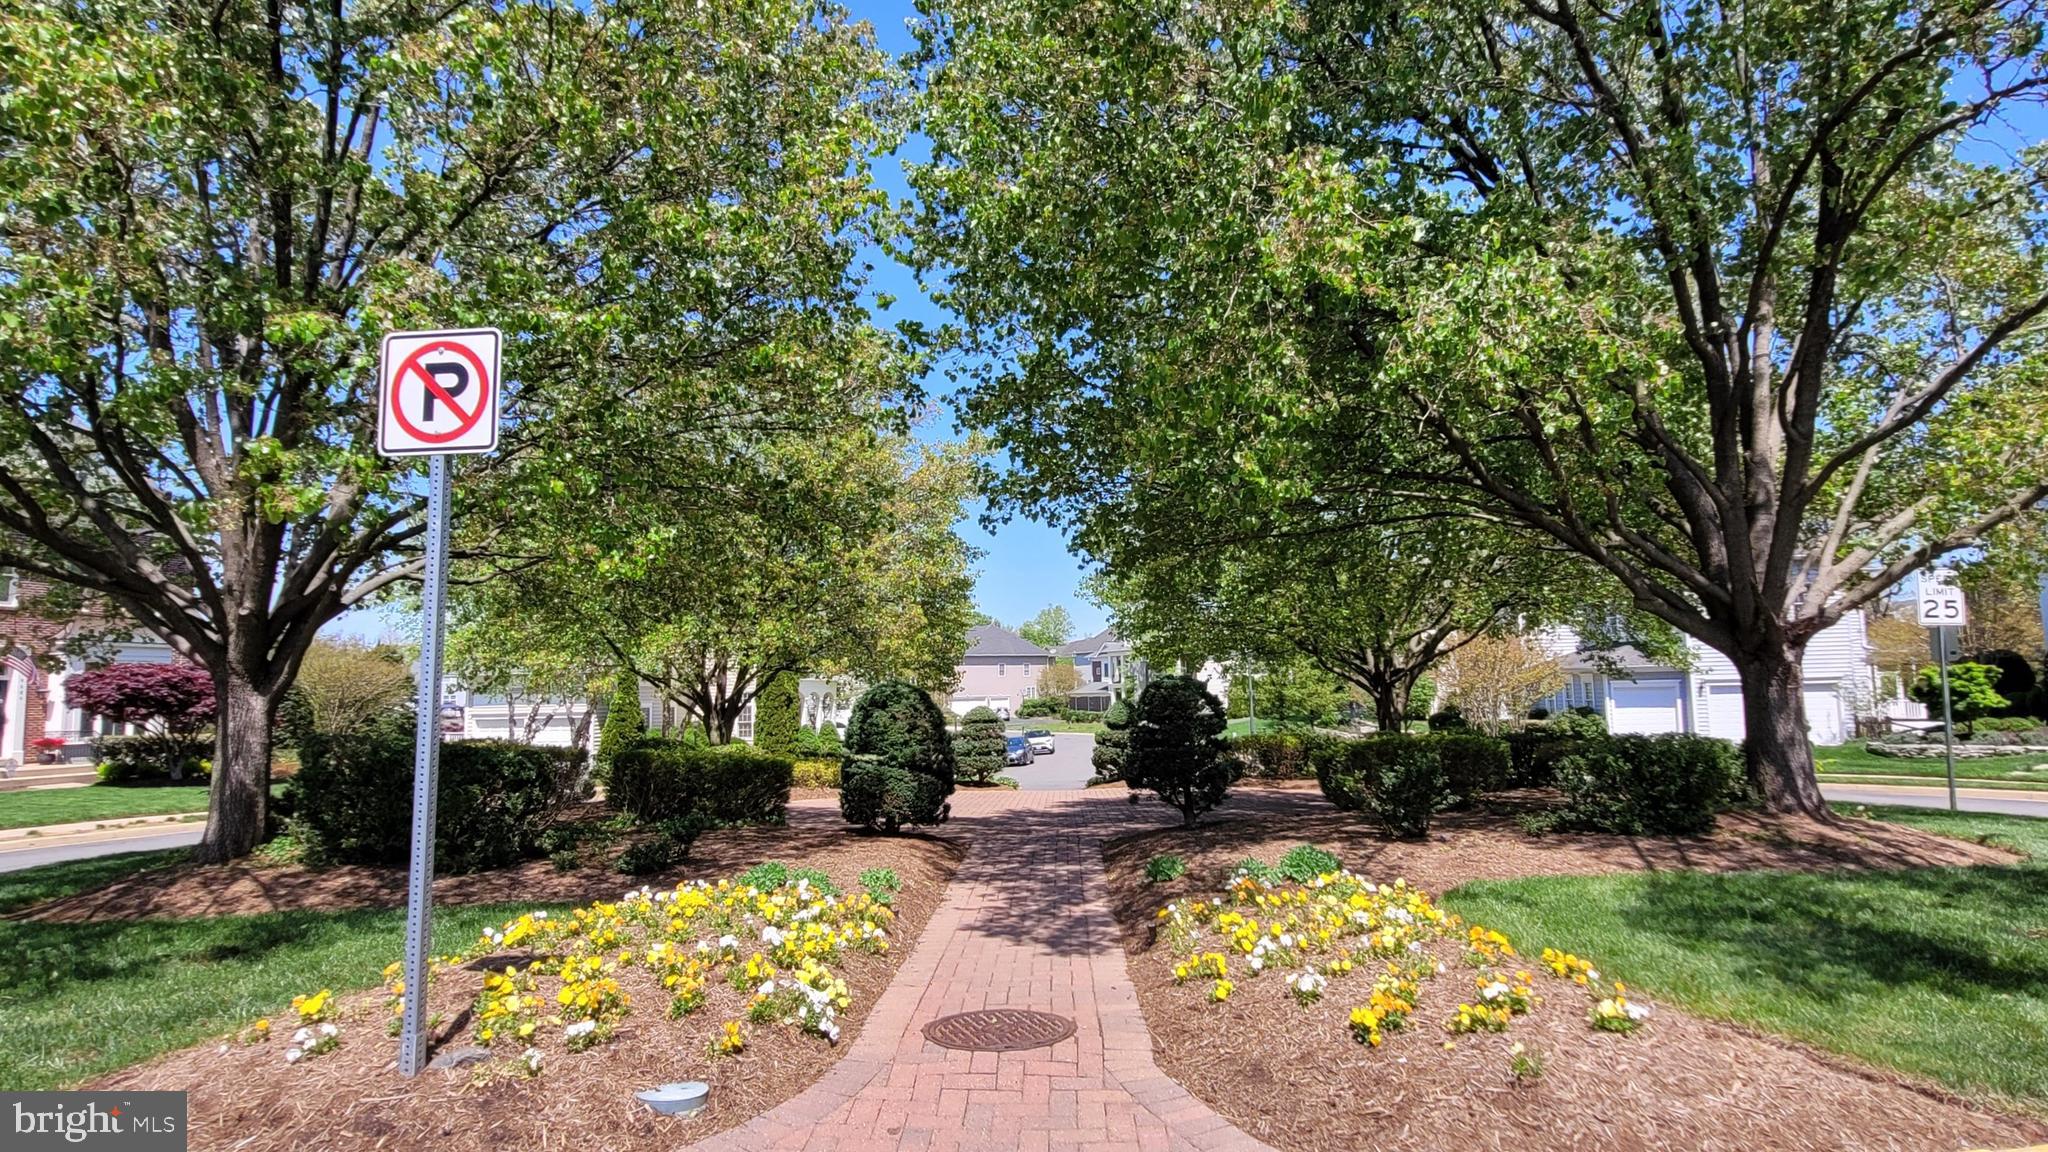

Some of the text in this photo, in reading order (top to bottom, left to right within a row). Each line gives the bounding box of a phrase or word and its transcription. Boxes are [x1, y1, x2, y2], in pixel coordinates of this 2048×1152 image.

[422, 361, 469, 422] P
[1925, 587, 1953, 596] LIMIT
[1923, 599, 1959, 618] 25
